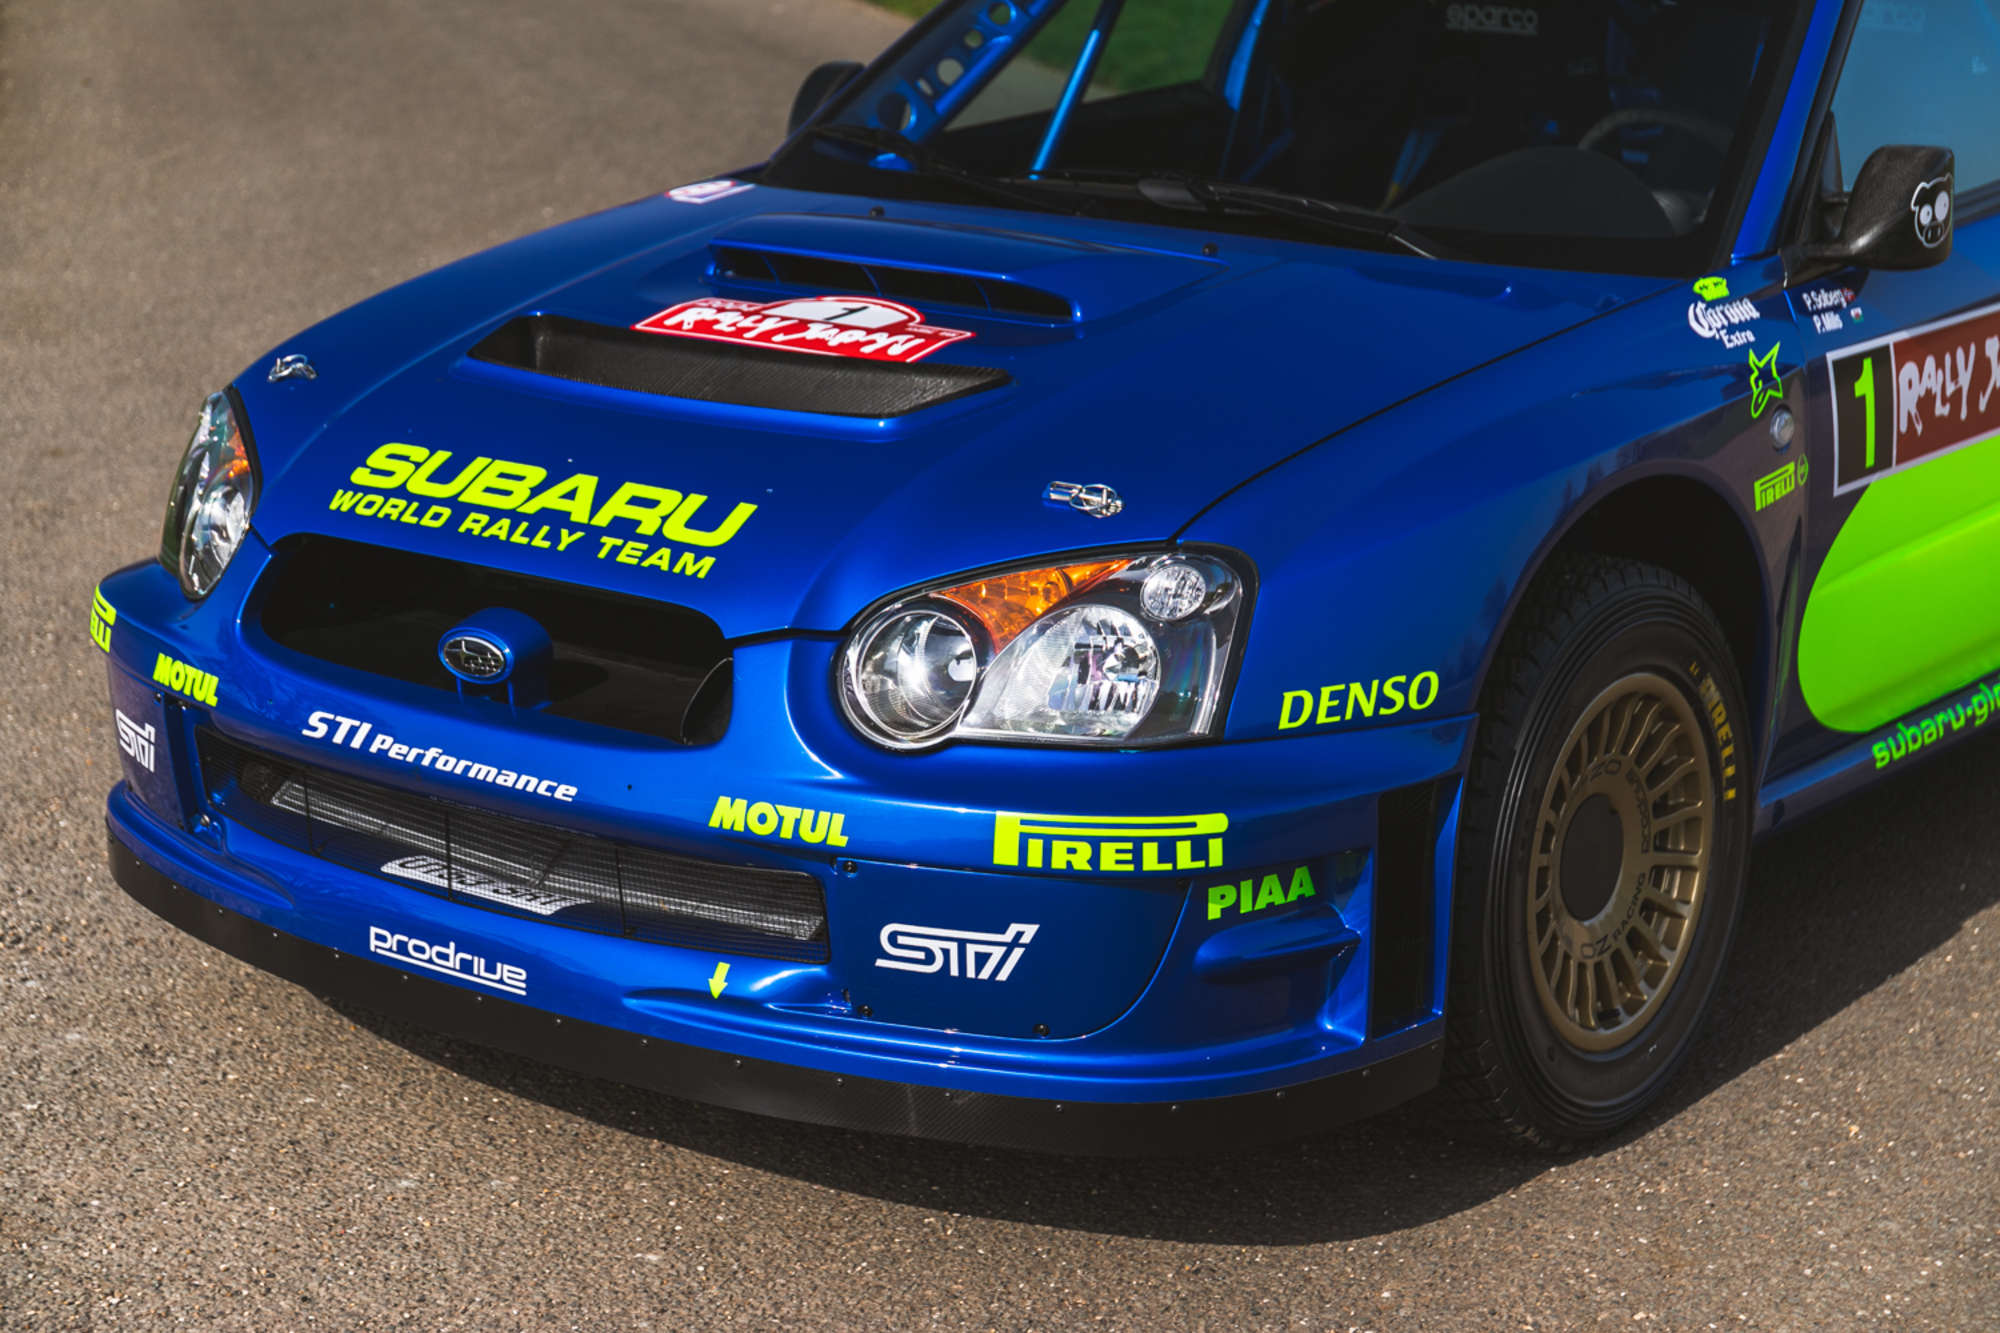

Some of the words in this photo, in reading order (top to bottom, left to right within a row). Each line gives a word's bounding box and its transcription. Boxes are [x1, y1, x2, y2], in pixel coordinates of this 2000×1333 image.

[823, 305, 872, 322] 1
[1688, 297, 1761, 339] Corona
[1720, 329, 1756, 349] Extra
[1854, 357, 1877, 469] 1
[350, 442, 757, 548] SUBARU
[1754, 461, 1796, 514] PIRELLI
[329, 490, 452, 529] WORLD
[458, 512, 585, 555] RALLY
[597, 536, 716, 580] TEAM
[153, 652, 219, 707] MOTUL
[1278, 671, 1440, 731] DENSO
[301, 710, 373, 750] STI
[369, 733, 578, 803] Performance
[708, 796, 849, 848] MOTUL
[993, 811, 1229, 872] PIRELLI
[1207, 866, 1316, 920] PIAA
[370, 926, 527, 996] prodrive
